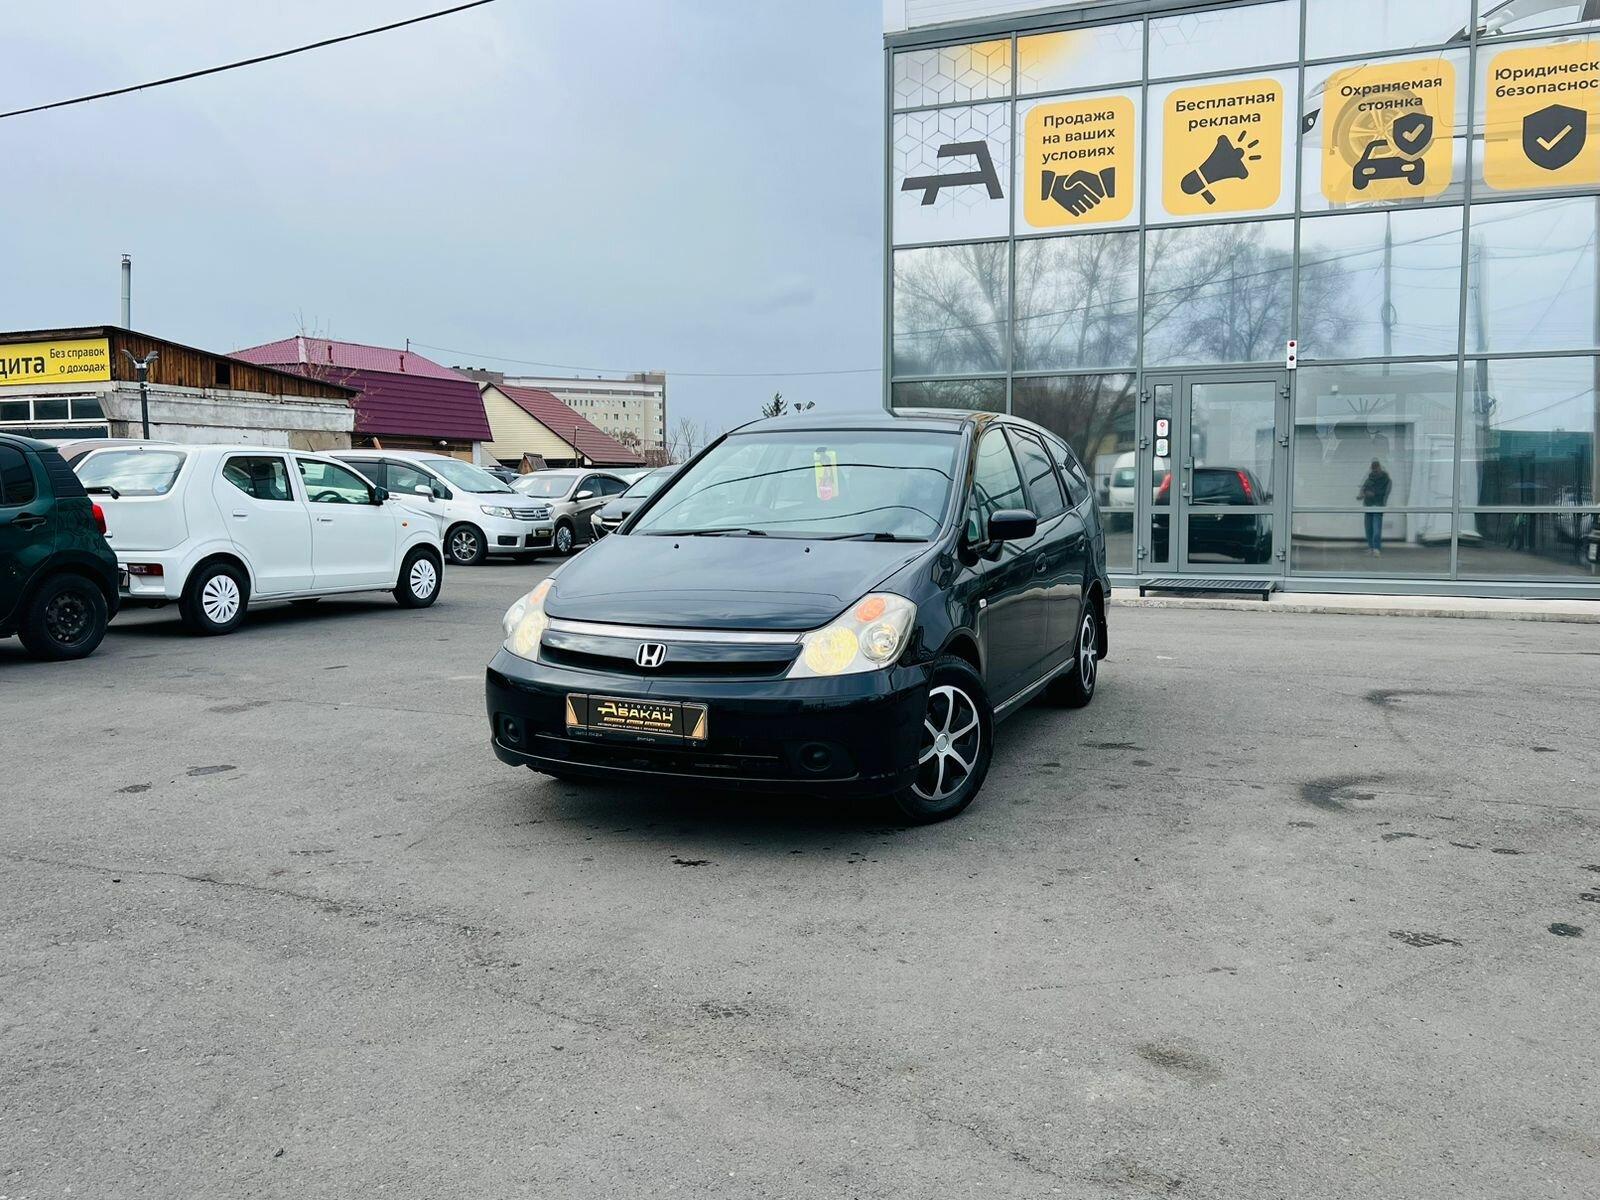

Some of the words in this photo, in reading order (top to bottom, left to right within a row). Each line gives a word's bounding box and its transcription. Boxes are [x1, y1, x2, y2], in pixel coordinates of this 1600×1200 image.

[1495, 60, 1600, 81] Юридическ
[1341, 78, 1443, 98] Охраняемая
[1495, 79, 1599, 98] безопаснос
[1175, 91, 1275, 112] Бесплатная
[1358, 97, 1424, 112] стоянка
[1043, 109, 1115, 127] Продажа
[1188, 112, 1261, 132] реклама
[1042, 134, 1061, 144] на
[1065, 128, 1116, 143] ваших
[1042, 145, 1115, 164] условиях
[50, 348, 66, 359] Без
[67, 348, 105, 359] справок
[59, 365, 66, 373] о
[67, 363, 106, 374] доходах
